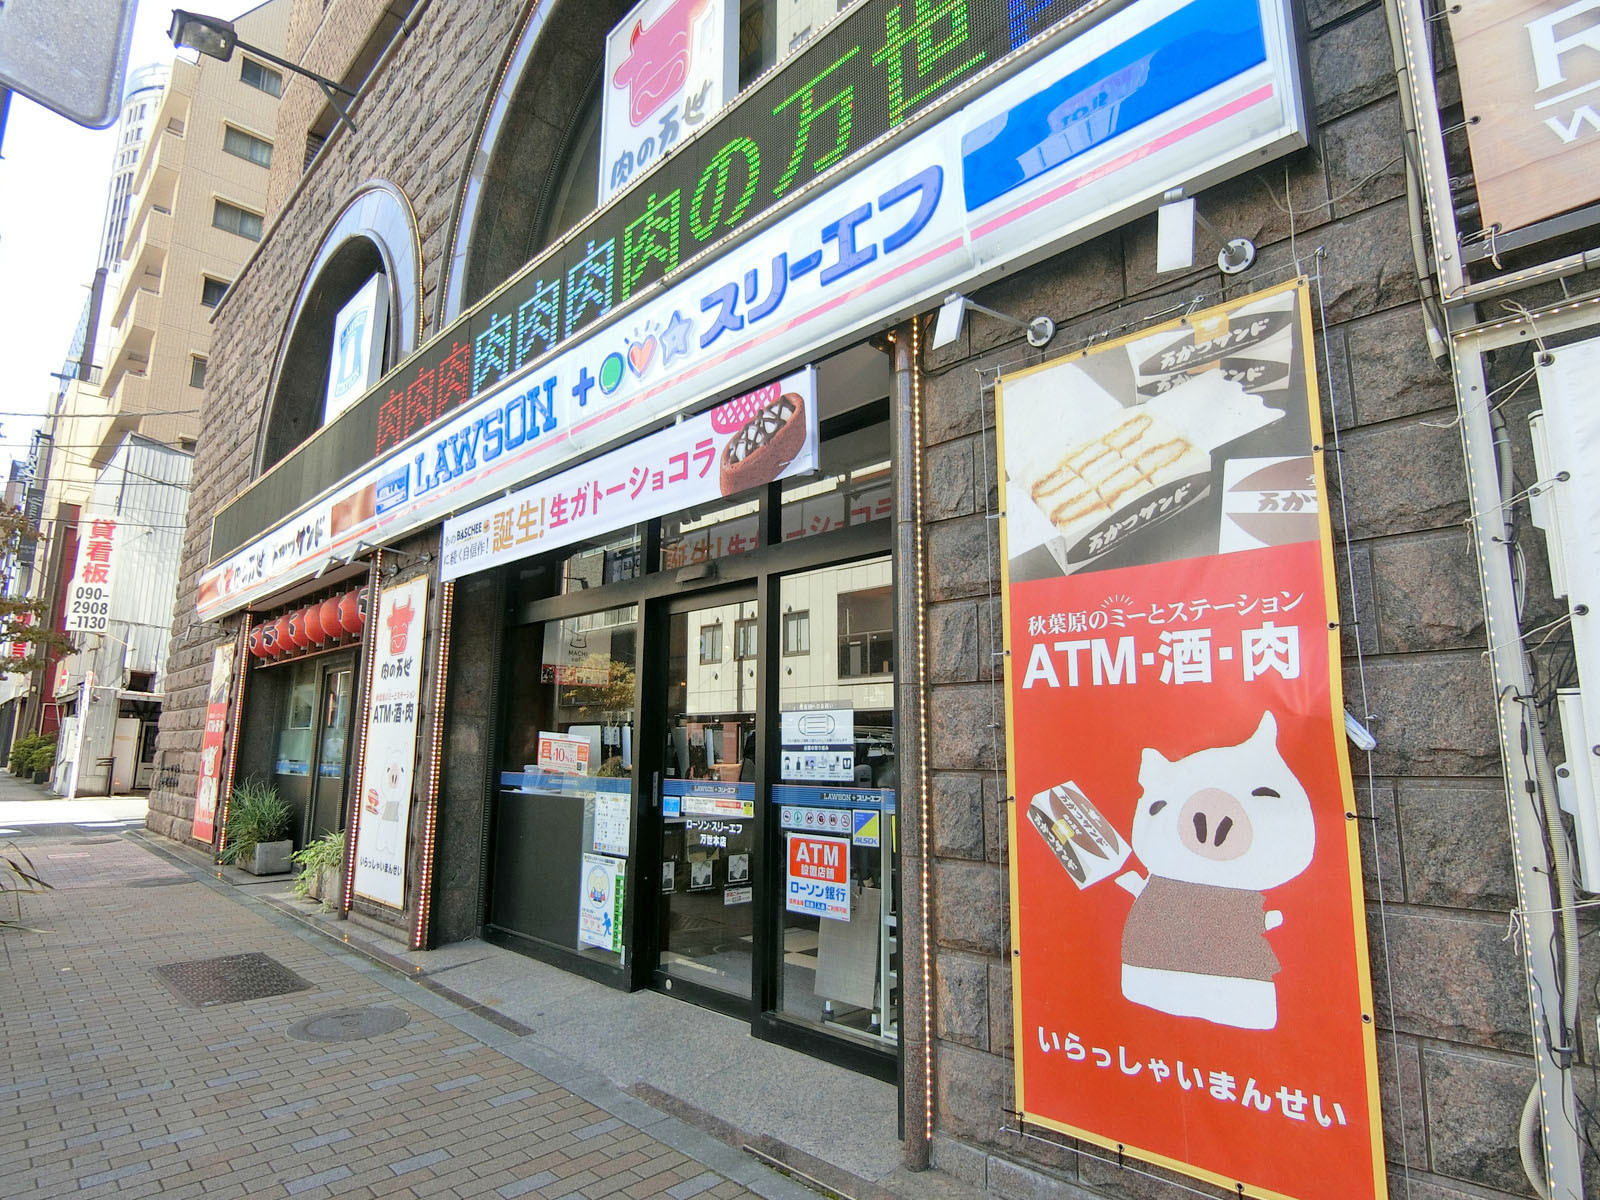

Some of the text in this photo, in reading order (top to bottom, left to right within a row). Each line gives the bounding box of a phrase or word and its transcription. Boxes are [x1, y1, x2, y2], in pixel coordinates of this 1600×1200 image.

[413, 375, 558, 498] LAWSON
[700, 164, 944, 349] スリーエフ
[550, 437, 716, 529] 生ガトーショコラ
[1257, 491, 1318, 512] 万か
[1088, 482, 1193, 555] 万かつサンド
[82, 518, 117, 584] 貸看板
[76, 586, 109, 600] 090-
[73, 601, 108, 615] 2908
[1027, 590, 1304, 636] 秋葉原のミーとステーション
[70, 615, 106, 630] -1130
[381, 656, 413, 680] 肉の万世
[700, 834, 727, 848] 万世本店
[854, 837, 878, 845] ALSOK
[796, 842, 839, 867] ATM
[360, 856, 402, 877] いらっしゃいまんせい
[791, 881, 847, 902] ローソン銀行
[1038, 1026, 1347, 1127] いらっしゃいまんせい
